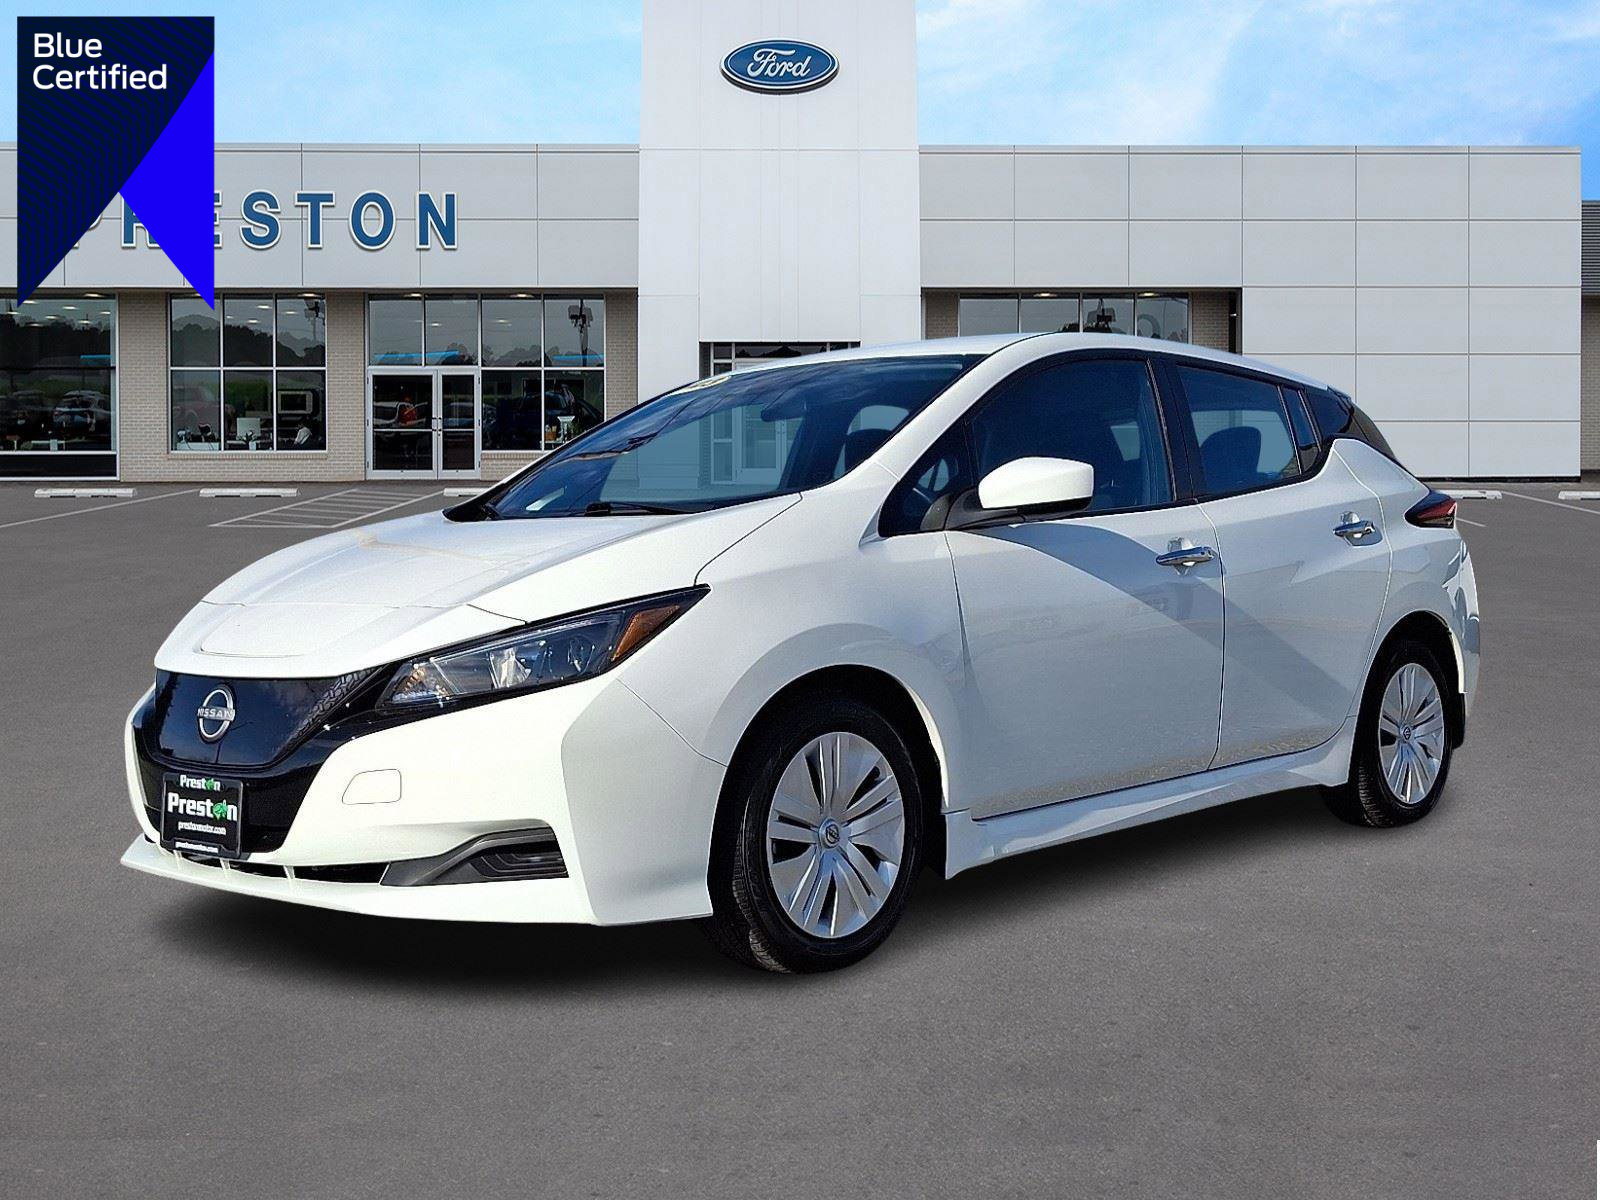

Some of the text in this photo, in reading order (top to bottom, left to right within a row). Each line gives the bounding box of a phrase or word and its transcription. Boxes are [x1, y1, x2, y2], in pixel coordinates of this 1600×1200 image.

[747, 48, 811, 77] Ford
[72, 190, 458, 250] RSTON
[197, 707, 235, 720] NISSAN
[180, 774, 220, 791] Preston
[167, 792, 238, 822] Preston
